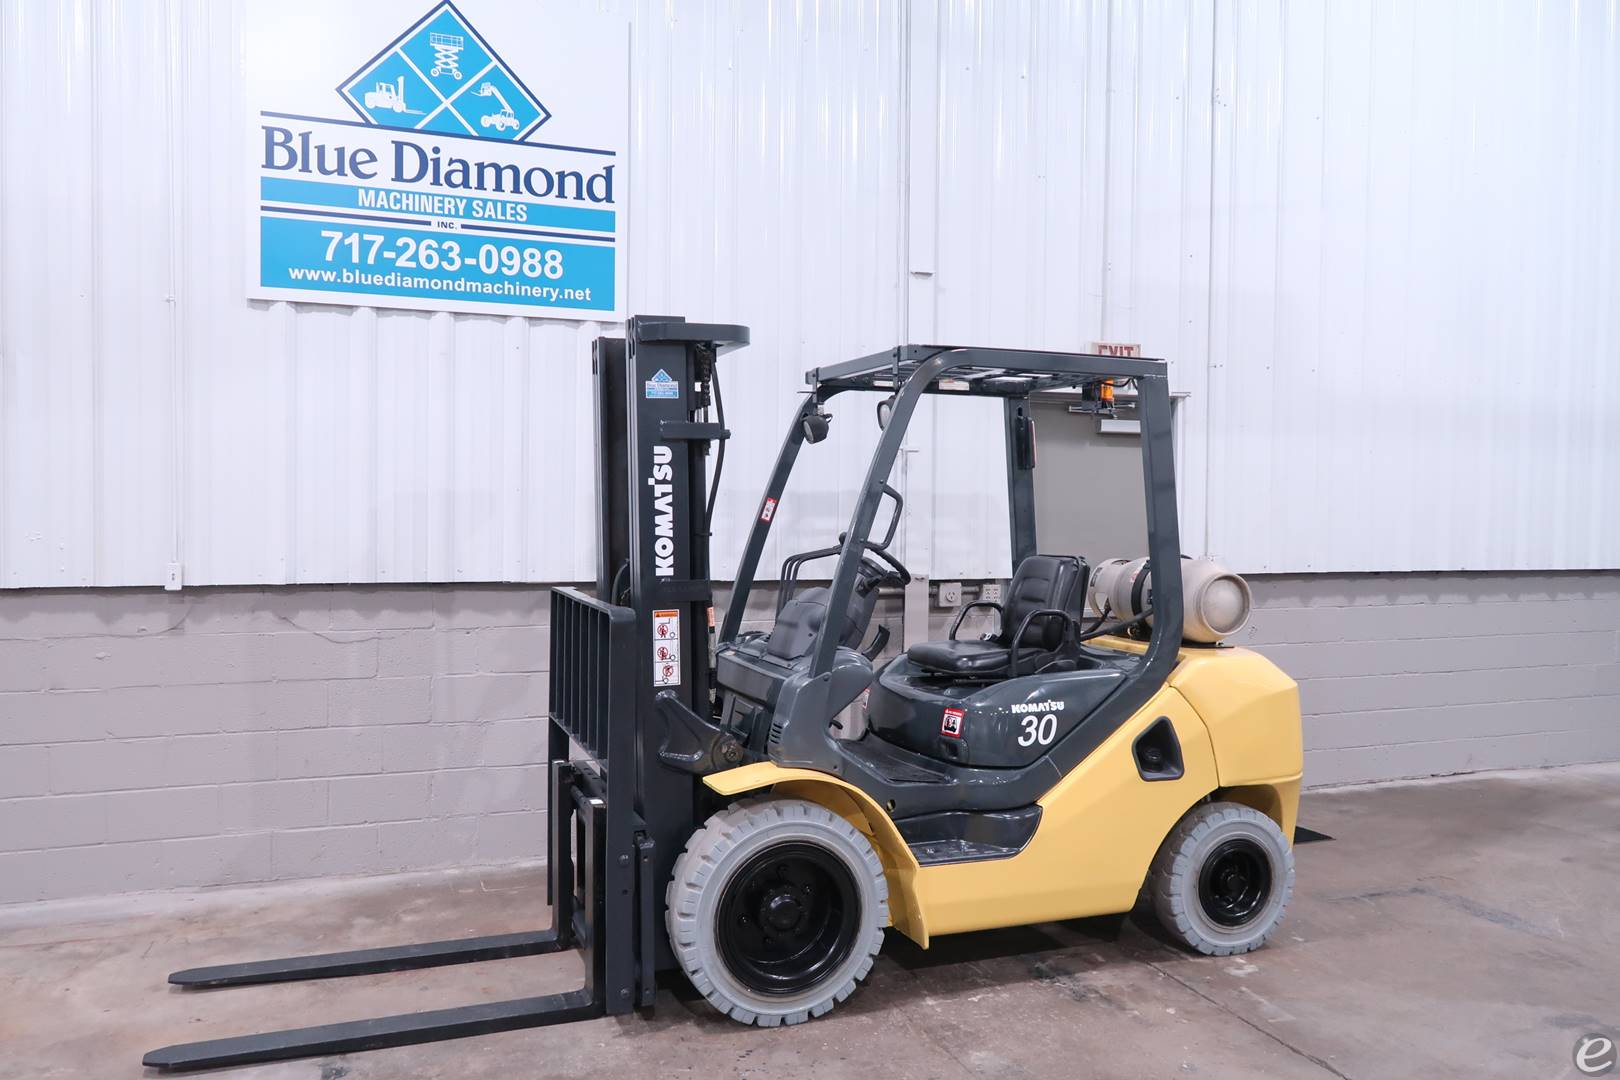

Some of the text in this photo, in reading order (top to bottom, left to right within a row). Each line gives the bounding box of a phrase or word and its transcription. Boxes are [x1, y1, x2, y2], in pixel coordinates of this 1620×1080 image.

[261, 125, 615, 204] Blue Diamond
[357, 188, 528, 222] MACHINERY SALES
[437, 221, 458, 230] INC.
[320, 230, 564, 280] 717-263-0988
[288, 267, 592, 302] www.bluediamondmachinery.net
[648, 445, 675, 577] KOMATSU
[1011, 699, 1065, 714] KOMATSU
[1017, 713, 1058, 747] 30
